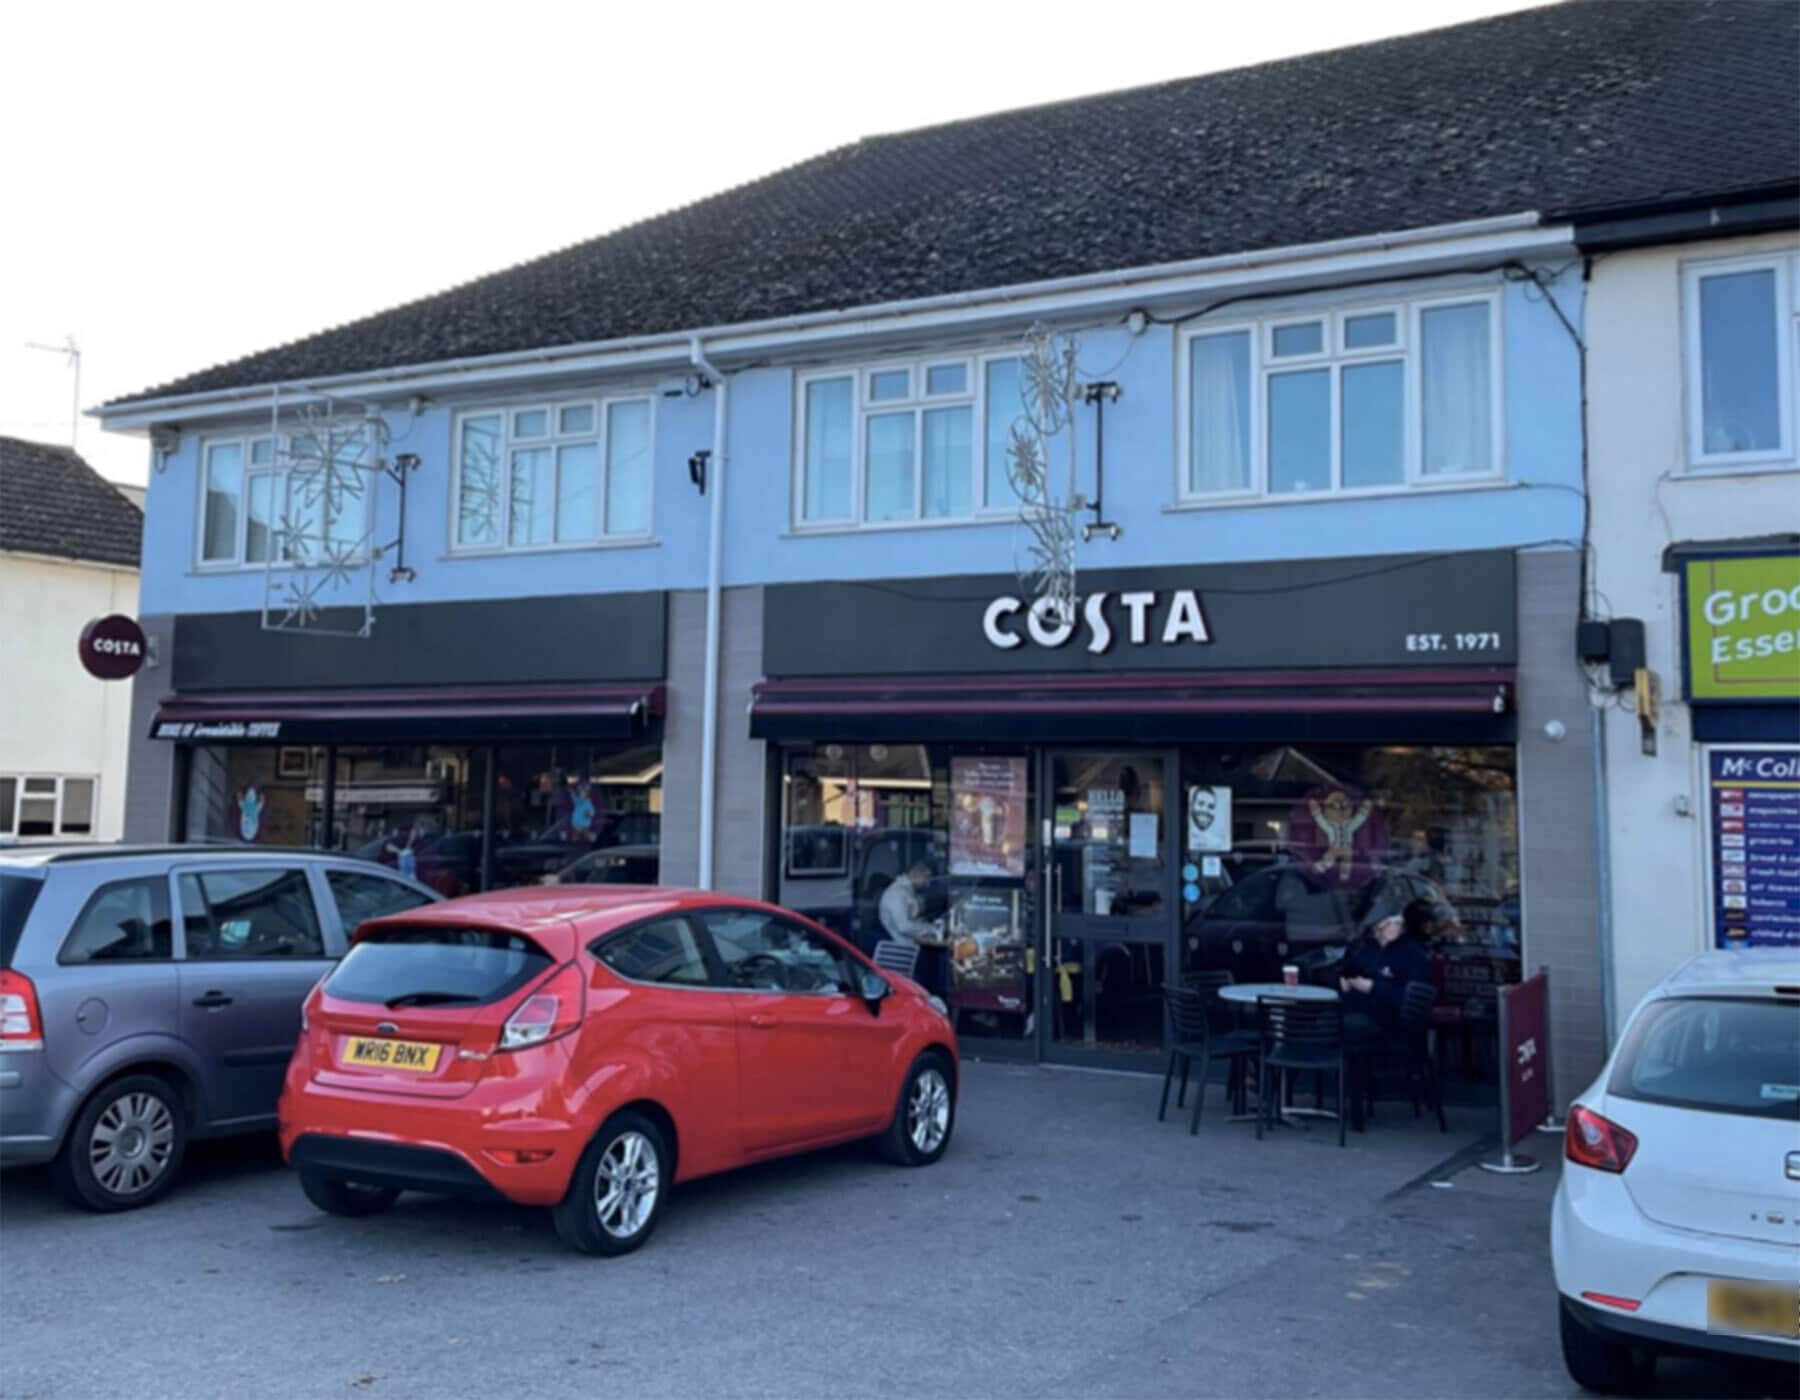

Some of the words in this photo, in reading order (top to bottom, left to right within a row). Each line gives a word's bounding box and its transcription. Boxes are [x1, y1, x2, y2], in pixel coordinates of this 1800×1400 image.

[984, 591, 1208, 652] COSTA
[93, 637, 141, 655] COSTA
[1406, 633, 1448, 651] EST.
[1456, 632, 1500, 650] 1971
[1711, 630, 1800, 664] Esse
[352, 1040, 389, 1062] WR16
[392, 1043, 429, 1066] BNX
